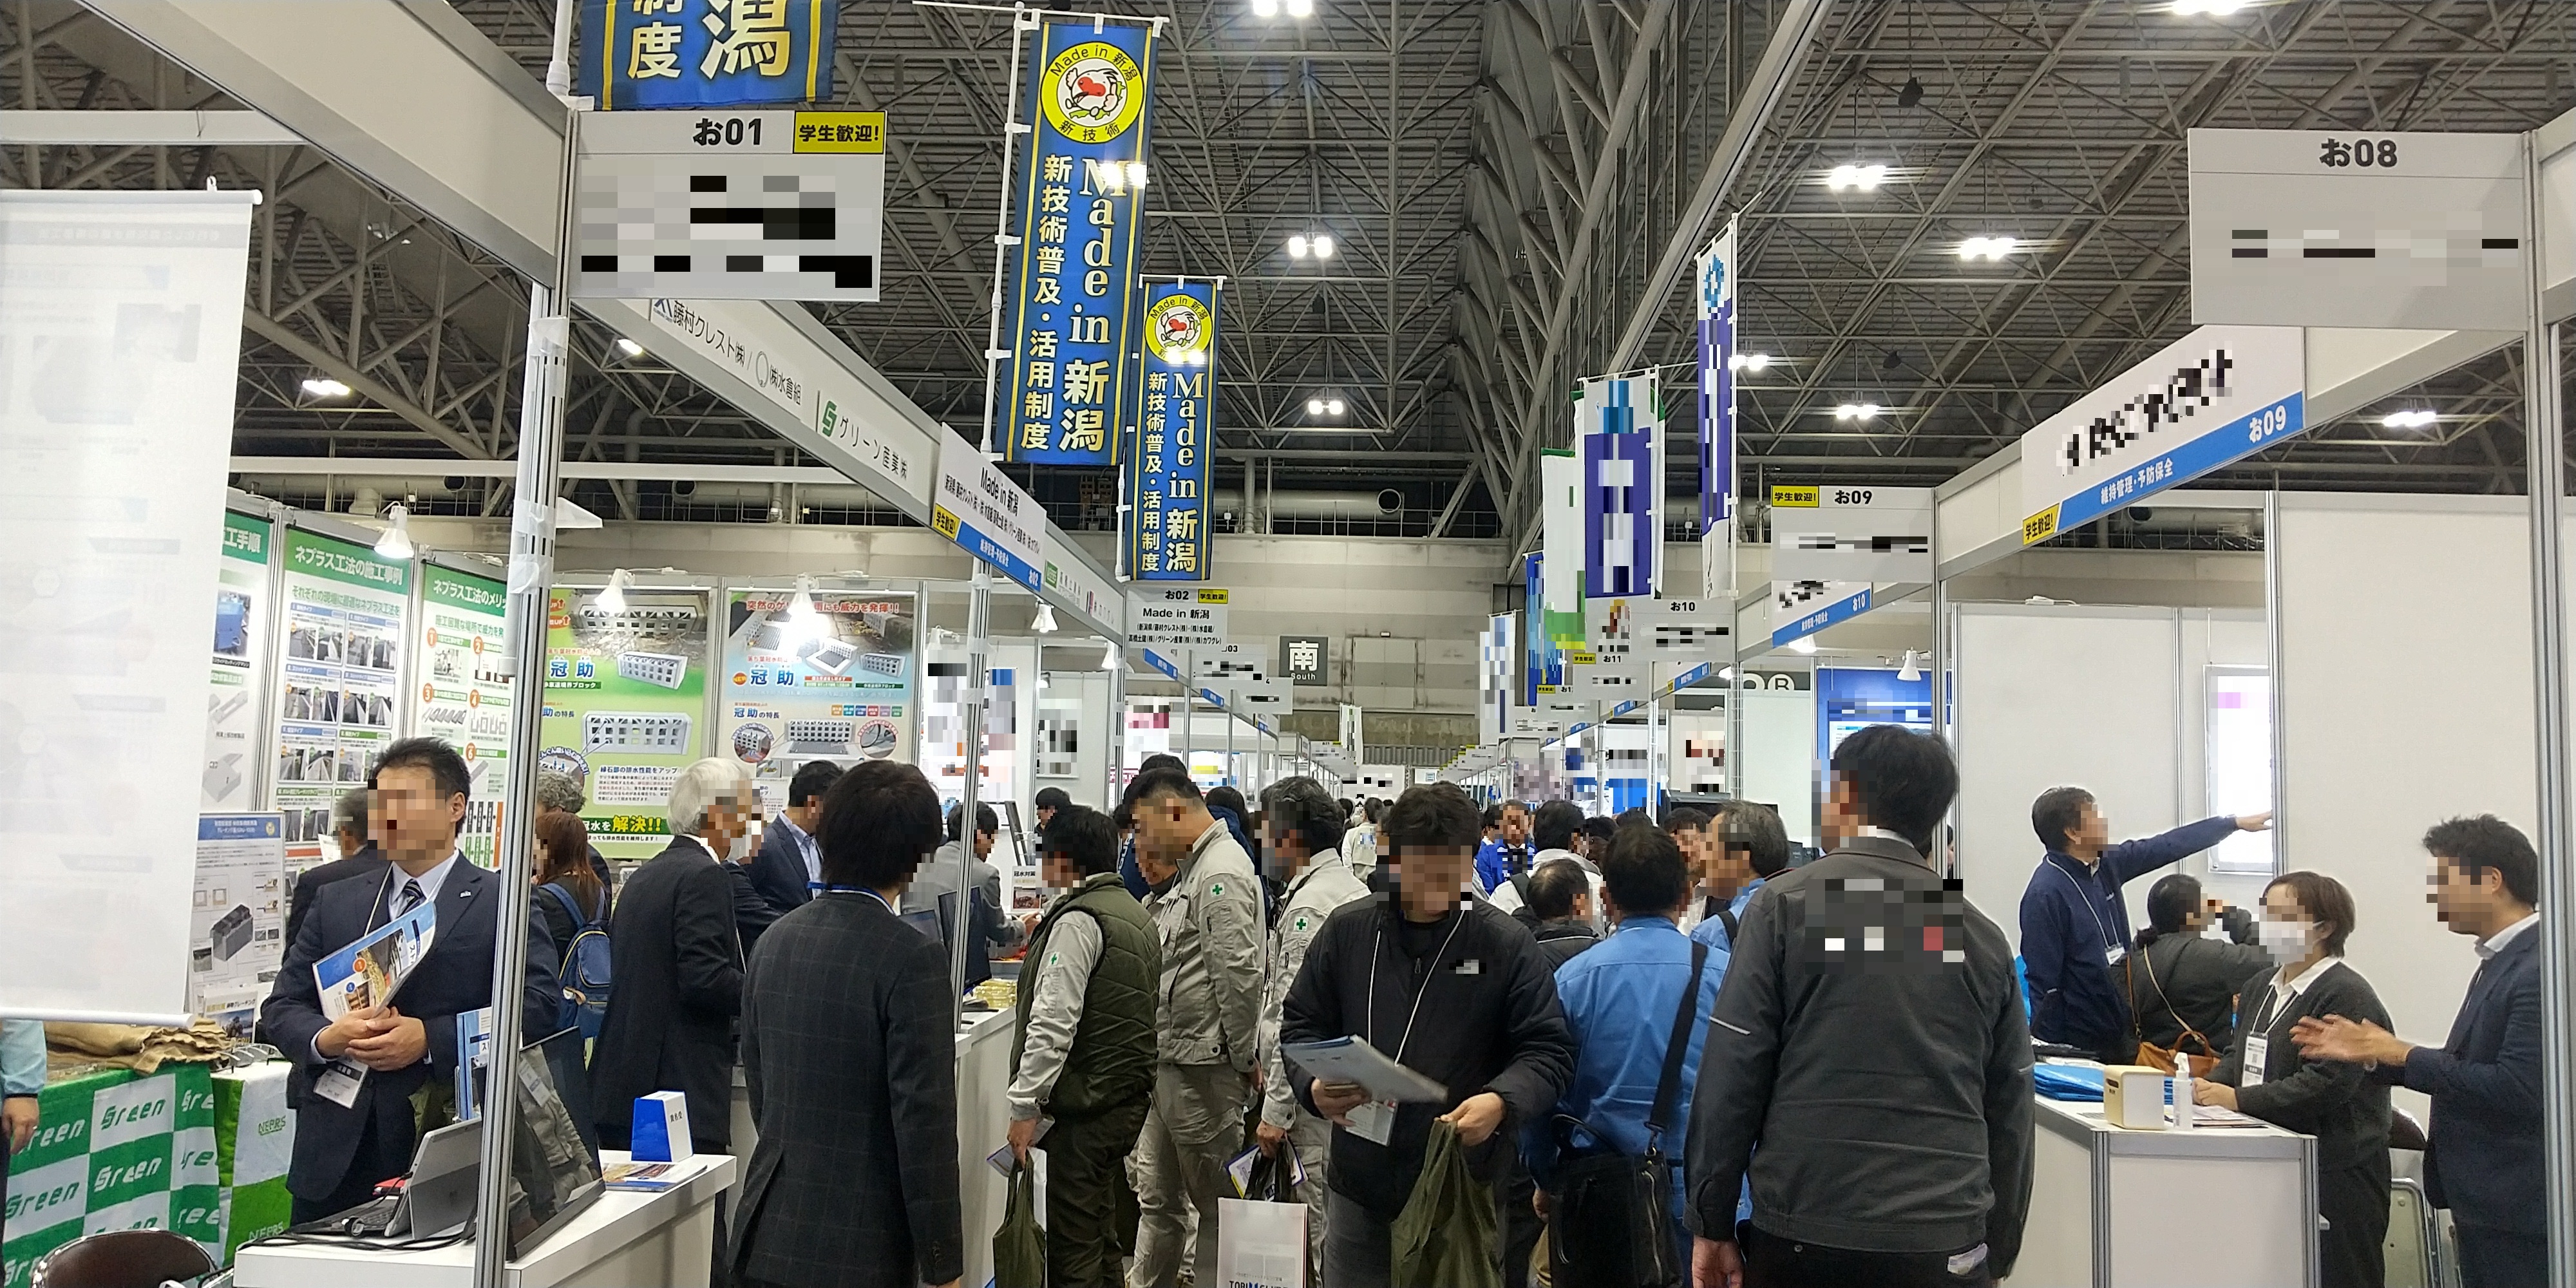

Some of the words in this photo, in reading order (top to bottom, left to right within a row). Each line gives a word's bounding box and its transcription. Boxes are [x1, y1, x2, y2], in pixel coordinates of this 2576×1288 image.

[627, 0, 681, 79] 度
[1050, 48, 1089, 76] Made
[1095, 44, 1108, 57] in
[1112, 52, 1138, 81] 新潟
[693, 118, 762, 146] お01
[799, 124, 880, 142] 学生歓迎!
[1059, 120, 1120, 142] 新技術
[2319, 138, 2398, 167] お08
[1080, 158, 1128, 297] Made
[1021, 154, 1073, 450] 新技術普及・活用制度
[1151, 298, 1177, 319] Made
[1068, 304, 1110, 343] in
[1059, 359, 1110, 451] 新潟
[1173, 373, 1204, 466] Made
[2249, 406, 2286, 442] お09
[981, 467, 999, 500] Made
[1000, 484, 1006, 506] in
[1141, 372, 1168, 572] 新技術普及・活用制度
[1169, 471, 1197, 498] in
[2101, 457, 2174, 505] 維持管理・予防保全
[1774, 492, 1816, 502] 学生歓迎!
[1835, 490, 1872, 505] お09
[1166, 508, 1198, 572] 新潟
[2025, 513, 2054, 540] 学生歓迎!
[1165, 590, 1189, 600] お02
[1670, 602, 1696, 611] お10
[1143, 608, 1173, 618] Made
[1177, 609, 1186, 618] in
[1289, 641, 1320, 671] 南
[21, 1119, 85, 1154] reen
